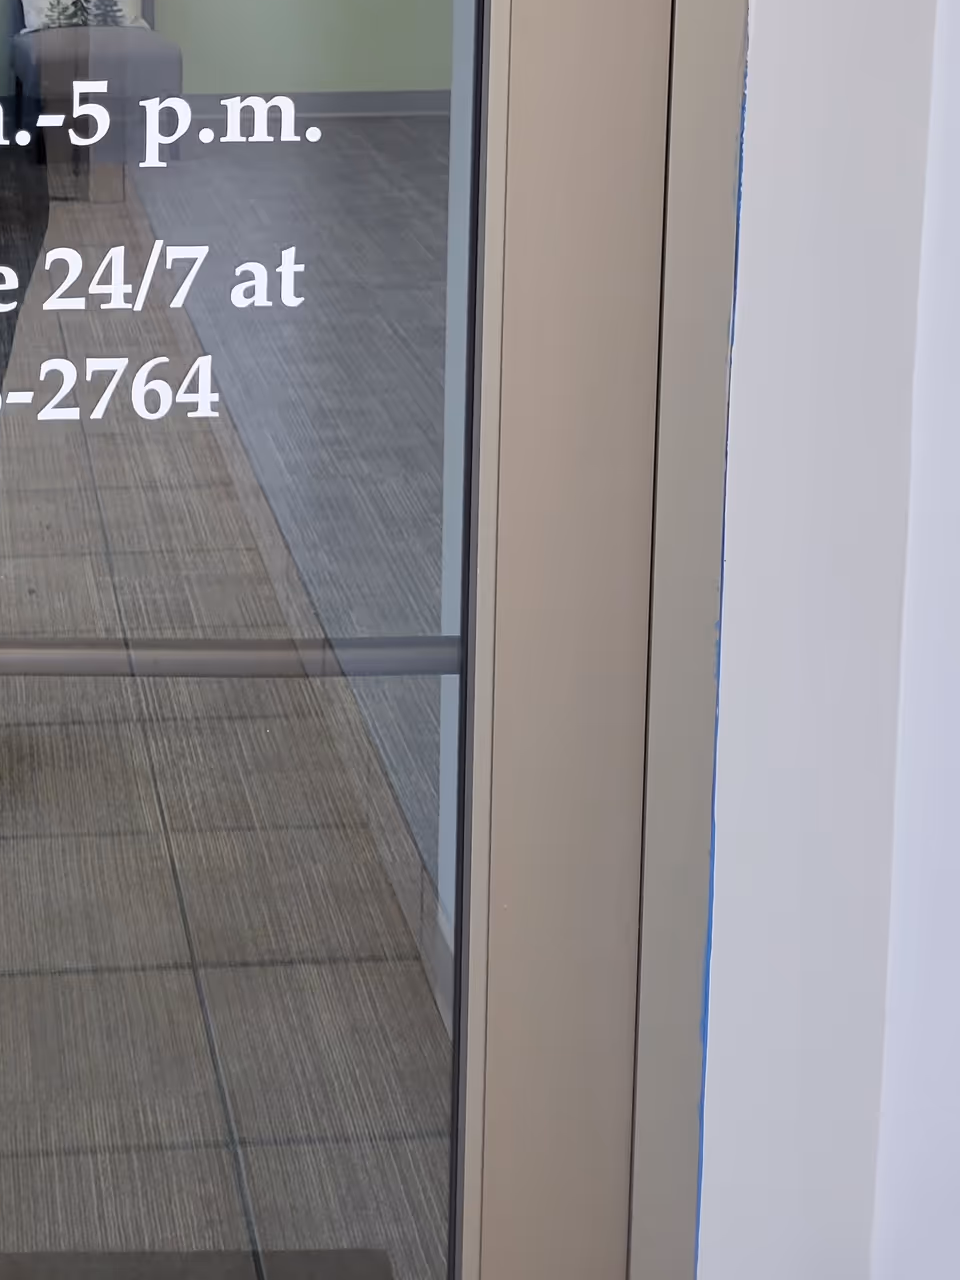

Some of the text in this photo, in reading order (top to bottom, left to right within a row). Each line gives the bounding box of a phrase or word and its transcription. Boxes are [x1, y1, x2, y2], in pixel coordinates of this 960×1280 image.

[139, 95, 323, 168] p.m.
[42, 239, 210, 311] 24/7
[230, 245, 306, 308] at
